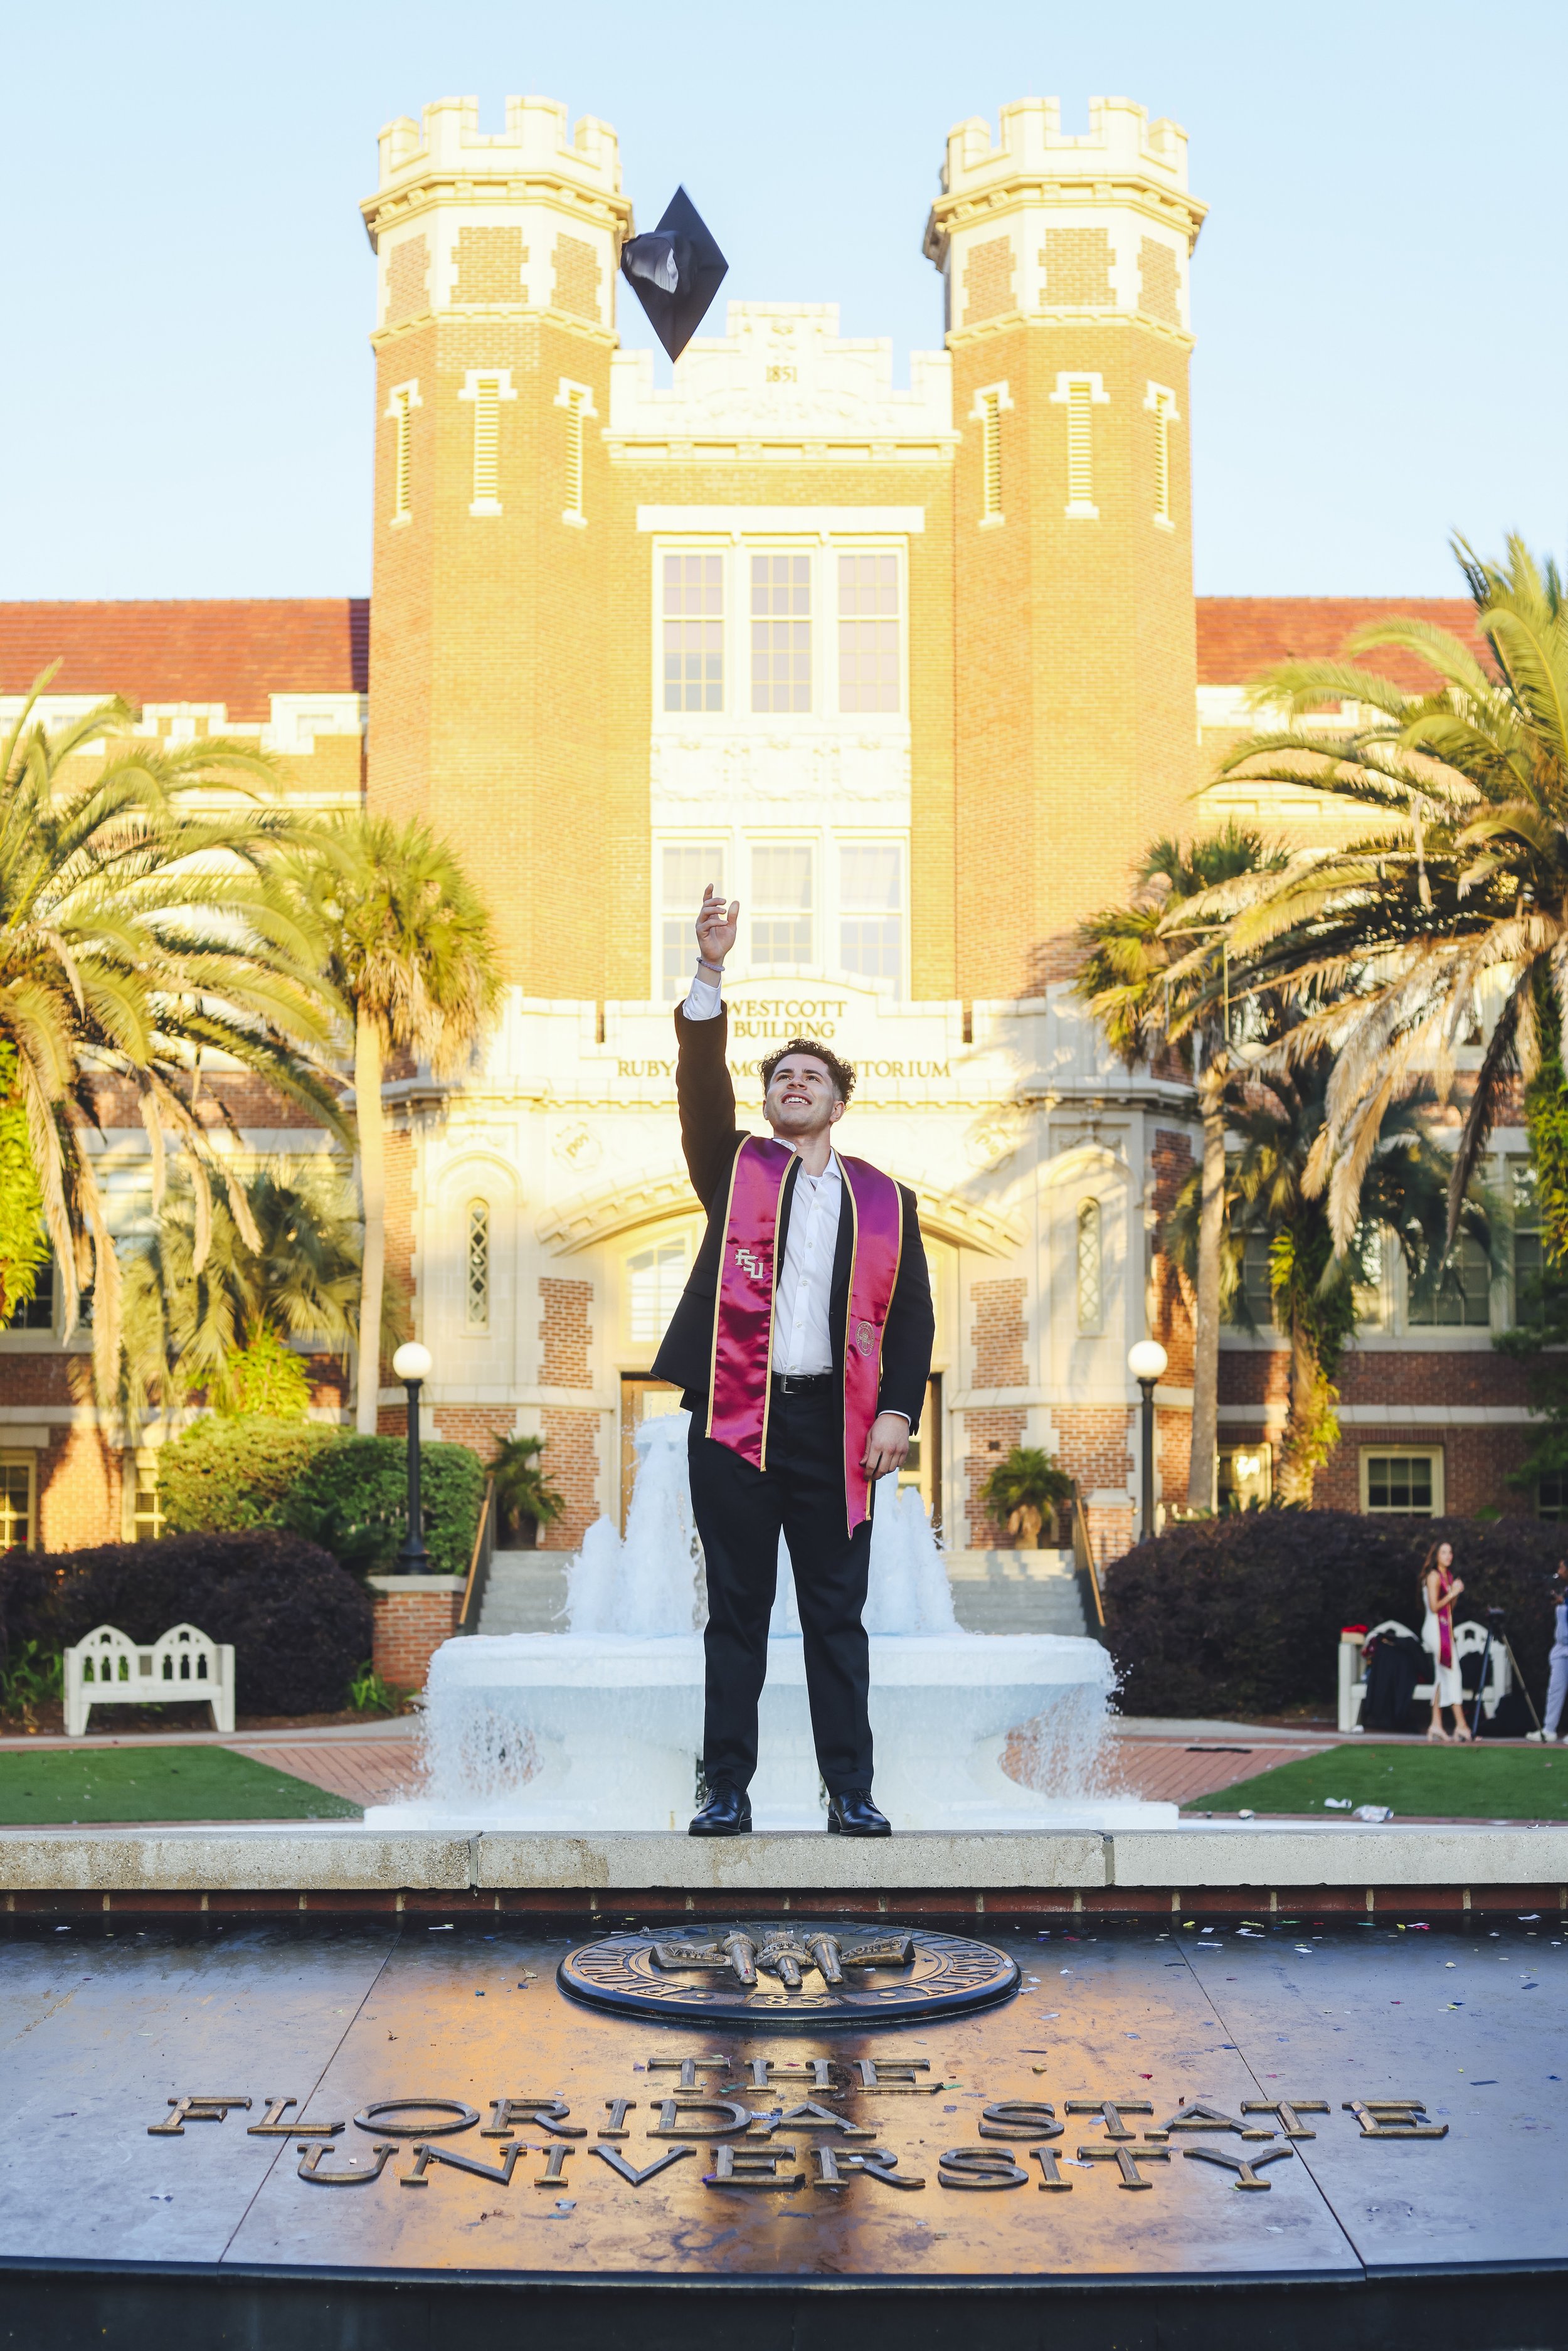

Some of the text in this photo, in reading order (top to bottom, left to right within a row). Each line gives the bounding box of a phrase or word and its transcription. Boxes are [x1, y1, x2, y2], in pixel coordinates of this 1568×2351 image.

[766, 365, 798, 383] 1851
[727, 999, 847, 1017] WESTCOTT
[733, 1021, 835, 1039] BUILDING
[617, 1059, 951, 1078] RUBY ITORIUM
[734, 1249, 764, 1279] FSU
[647, 2057, 945, 2094] THE
[147, 2096, 1449, 2140] FLORIDA STATE
[296, 2141, 1294, 2192] UNIVERSITY
